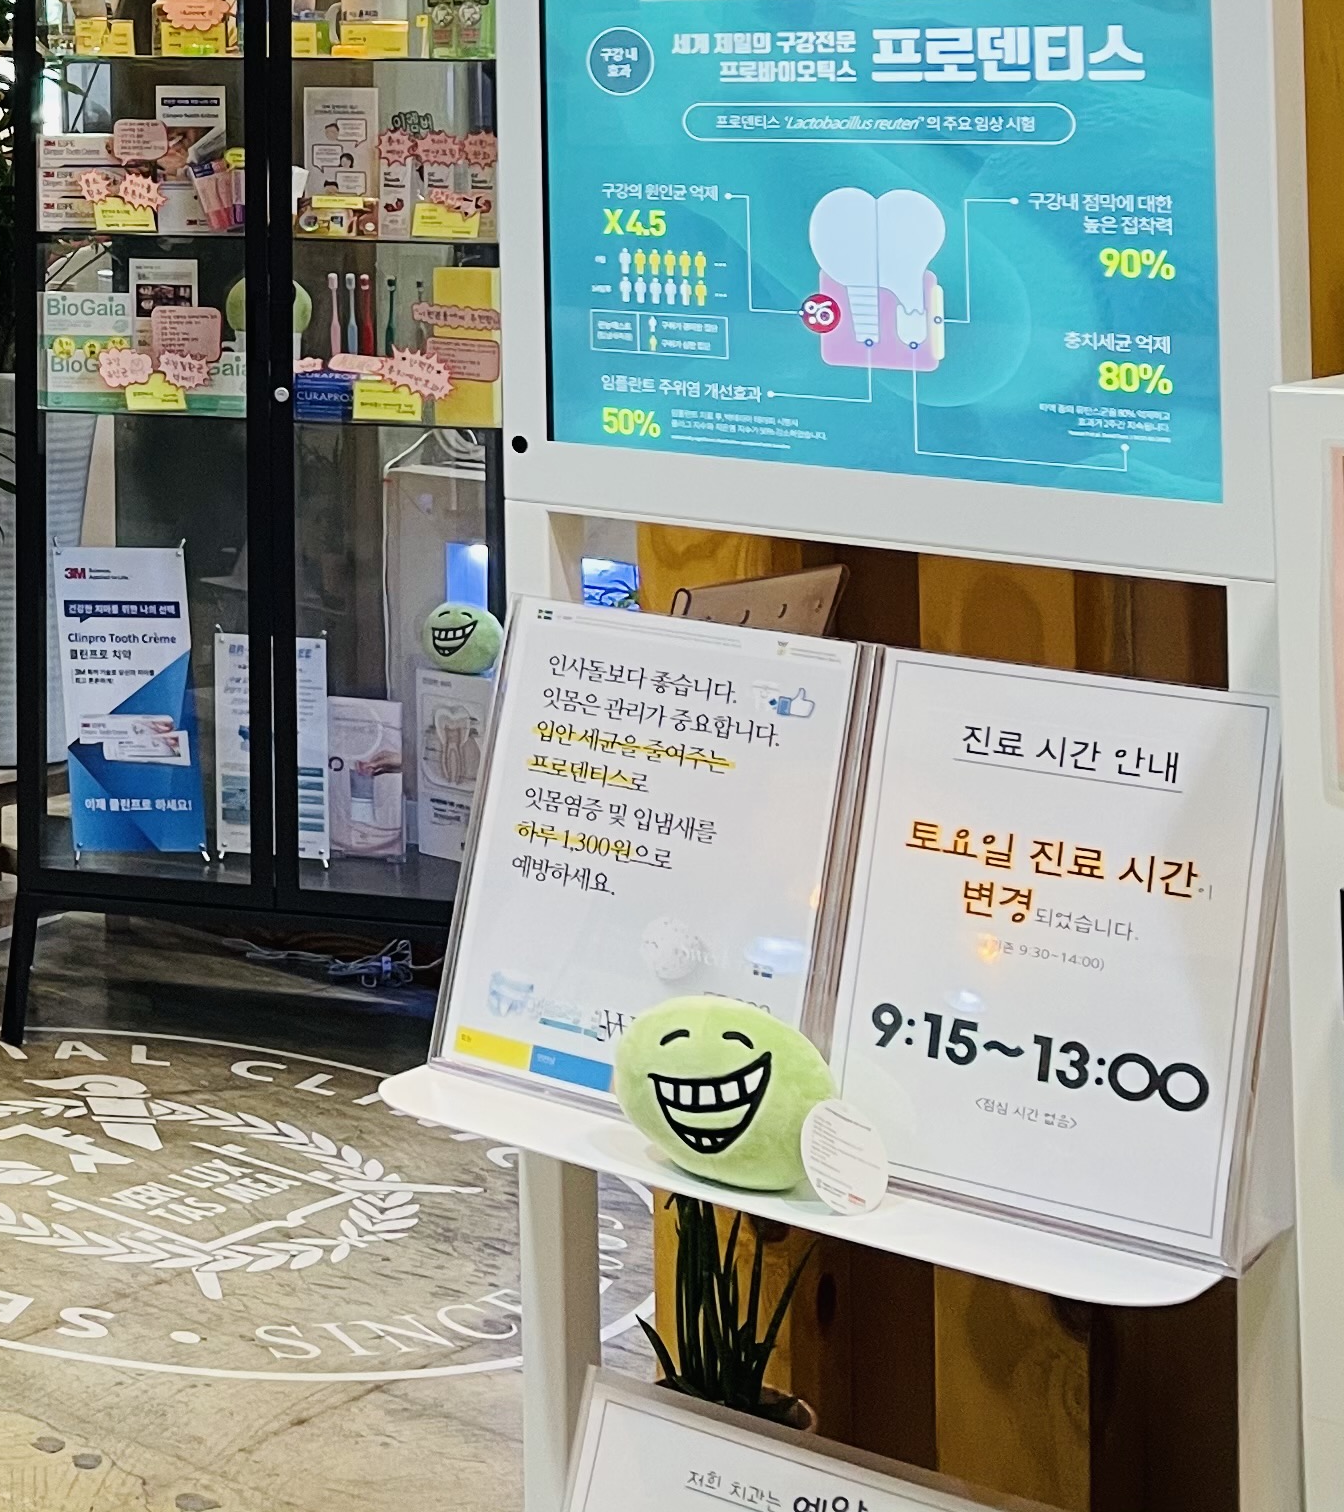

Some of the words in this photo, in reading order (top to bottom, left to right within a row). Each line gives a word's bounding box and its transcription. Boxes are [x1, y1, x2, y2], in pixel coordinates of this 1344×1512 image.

[713, 31, 772, 54] 제일의
[775, 30, 858, 54] 구강전문
[871, 24, 1147, 83] 프로덴티스
[718, 59, 858, 83] 프로바이오틱스
[715, 114, 781, 130] 프로덴티스
[926, 116, 941, 131] 의
[942, 116, 974, 132] 주요
[1006, 116, 1036, 133] 시험
[43, 139, 56, 147] 3M
[601, 182, 643, 201] 구강의
[644, 183, 688, 202] 원인균
[689, 184, 719, 202] 억제
[1027, 192, 1080, 212] 구강내
[1081, 193, 1135, 213] 점막에
[1137, 194, 1173, 214] 대한
[1083, 215, 1119, 235] 높은
[1120, 216, 1173, 236] 접착력
[1098, 247, 1177, 281] 90%
[46, 295, 127, 317] BioGaia
[1063, 331, 1133, 354] 충치세균
[1134, 335, 1172, 355] 억제
[600, 374, 657, 393] 임플란트
[658, 377, 701, 398] 주위염
[703, 382, 763, 403] 개선효과
[1098, 360, 1174, 395] 80%
[601, 406, 662, 439] 50%
[64, 567, 87, 580] 3M
[67, 632, 107, 645] Clinpro
[108, 633, 140, 644] Tooth
[141, 632, 177, 644] Crème
[548, 652, 647, 691] 인사돌보다
[649, 669, 737, 706] 좋습니다.
[542, 685, 602, 718] 잇몸은
[603, 695, 668, 729] 관리가
[669, 708, 781, 749] 중요합니다.
[535, 720, 576, 748] 입안
[577, 728, 640, 760] 세균을
[642, 740, 733, 776] 줄여주는
[960, 722, 1025, 760] 진료
[1035, 735, 1103, 773] 시간
[1113, 745, 1181, 785] 안내
[528, 753, 650, 795] 프로덴티스로
[84, 797, 107, 811] 이제
[154, 798, 193, 813] 하세요!
[524, 786, 604, 823] 잇몸염증
[608, 803, 627, 828] 및
[633, 807, 718, 846] 입냄새를
[516, 819, 557, 850] 하루
[560, 828, 674, 872] 1,300원으로
[906, 819, 1015, 869] 토요일
[1029, 838, 1105, 882] 진료
[511, 853, 616, 897] 예방하세요.
[870, 1001, 1211, 1114] 9:15~13:00
[974, 1096, 1009, 1118] <점심
[1012, 1102, 1040, 1125] 시간
[100, 1181, 189, 1210] VERI
[168, 1158, 254, 1189] LUX
[146, 1196, 227, 1225] TAS
[213, 1172, 304, 1204] MEA
[686, 1467, 722, 1490] 저희
[729, 1480, 783, 1511] 치과는
